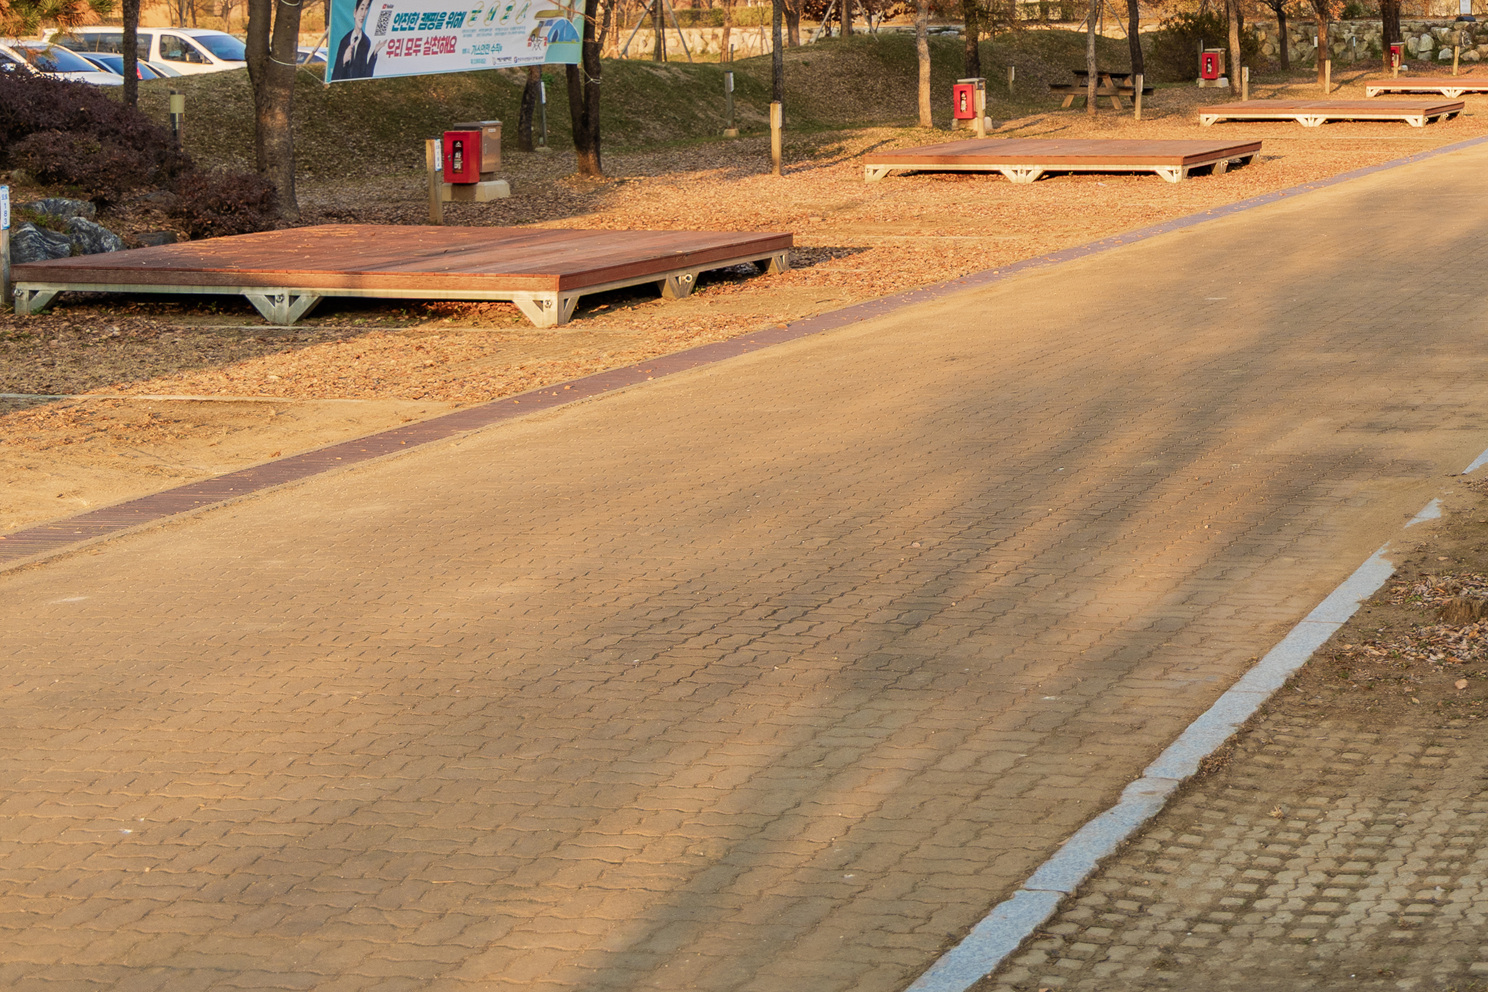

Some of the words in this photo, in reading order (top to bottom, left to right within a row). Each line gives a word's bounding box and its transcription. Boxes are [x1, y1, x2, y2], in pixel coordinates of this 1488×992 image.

[391, 11, 420, 32] 안전한
[417, 11, 447, 31] 캠핑을
[445, 10, 468, 29] 위해
[386, 37, 404, 58] 우리
[404, 37, 423, 57] 모두
[422, 35, 458, 56] 실천해요
